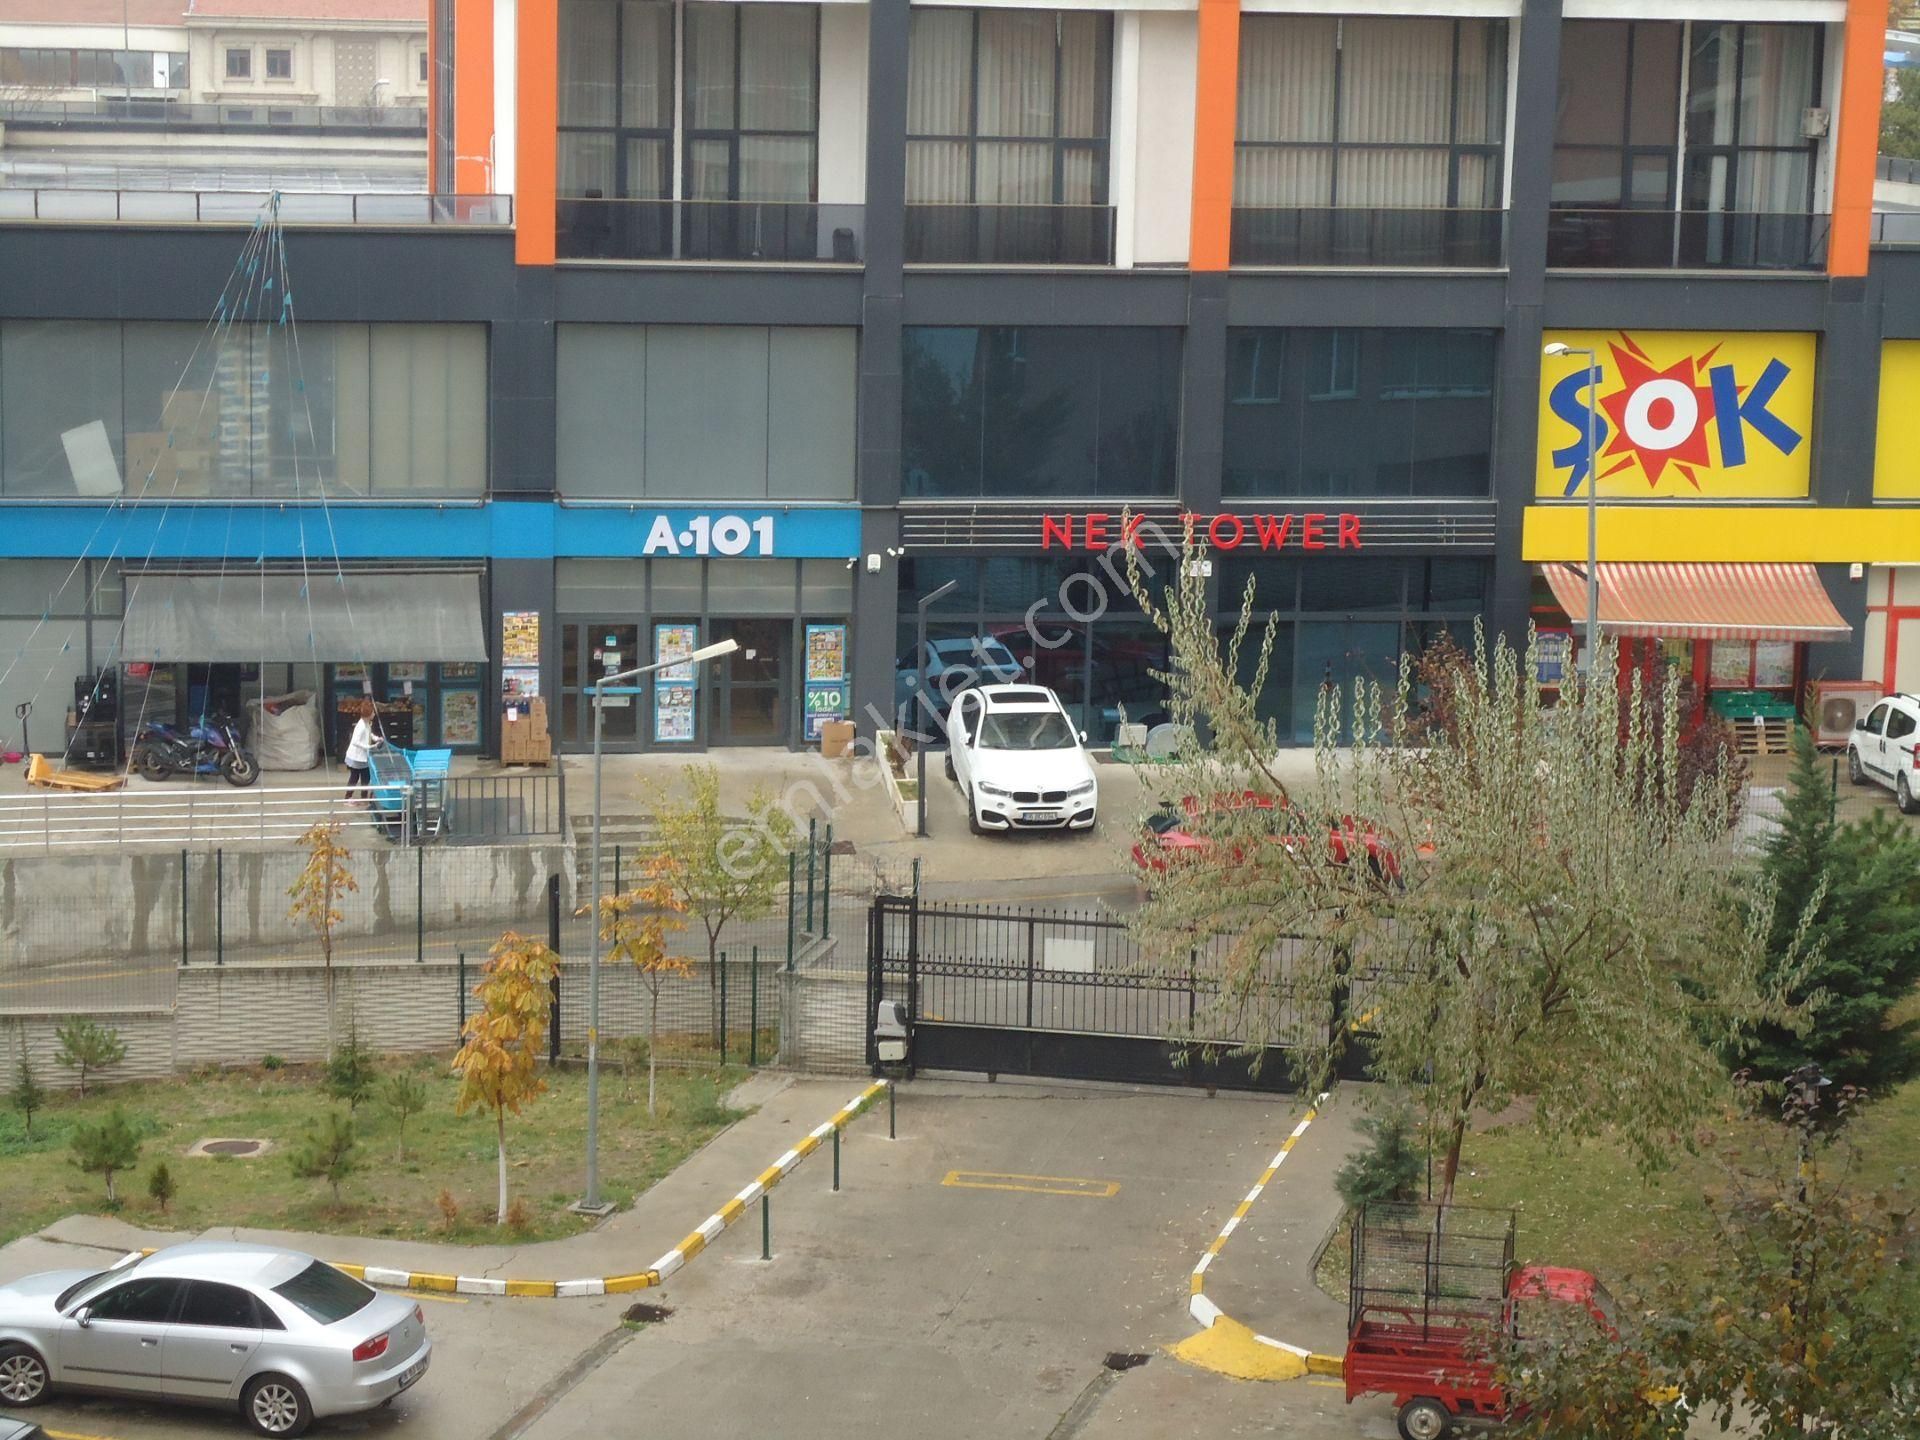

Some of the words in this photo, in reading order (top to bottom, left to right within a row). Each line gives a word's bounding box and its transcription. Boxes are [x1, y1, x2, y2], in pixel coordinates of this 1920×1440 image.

[1042, 513, 1145, 550] NEK
[1179, 513, 1362, 551] TOWER
[808, 690, 841, 707] %10
